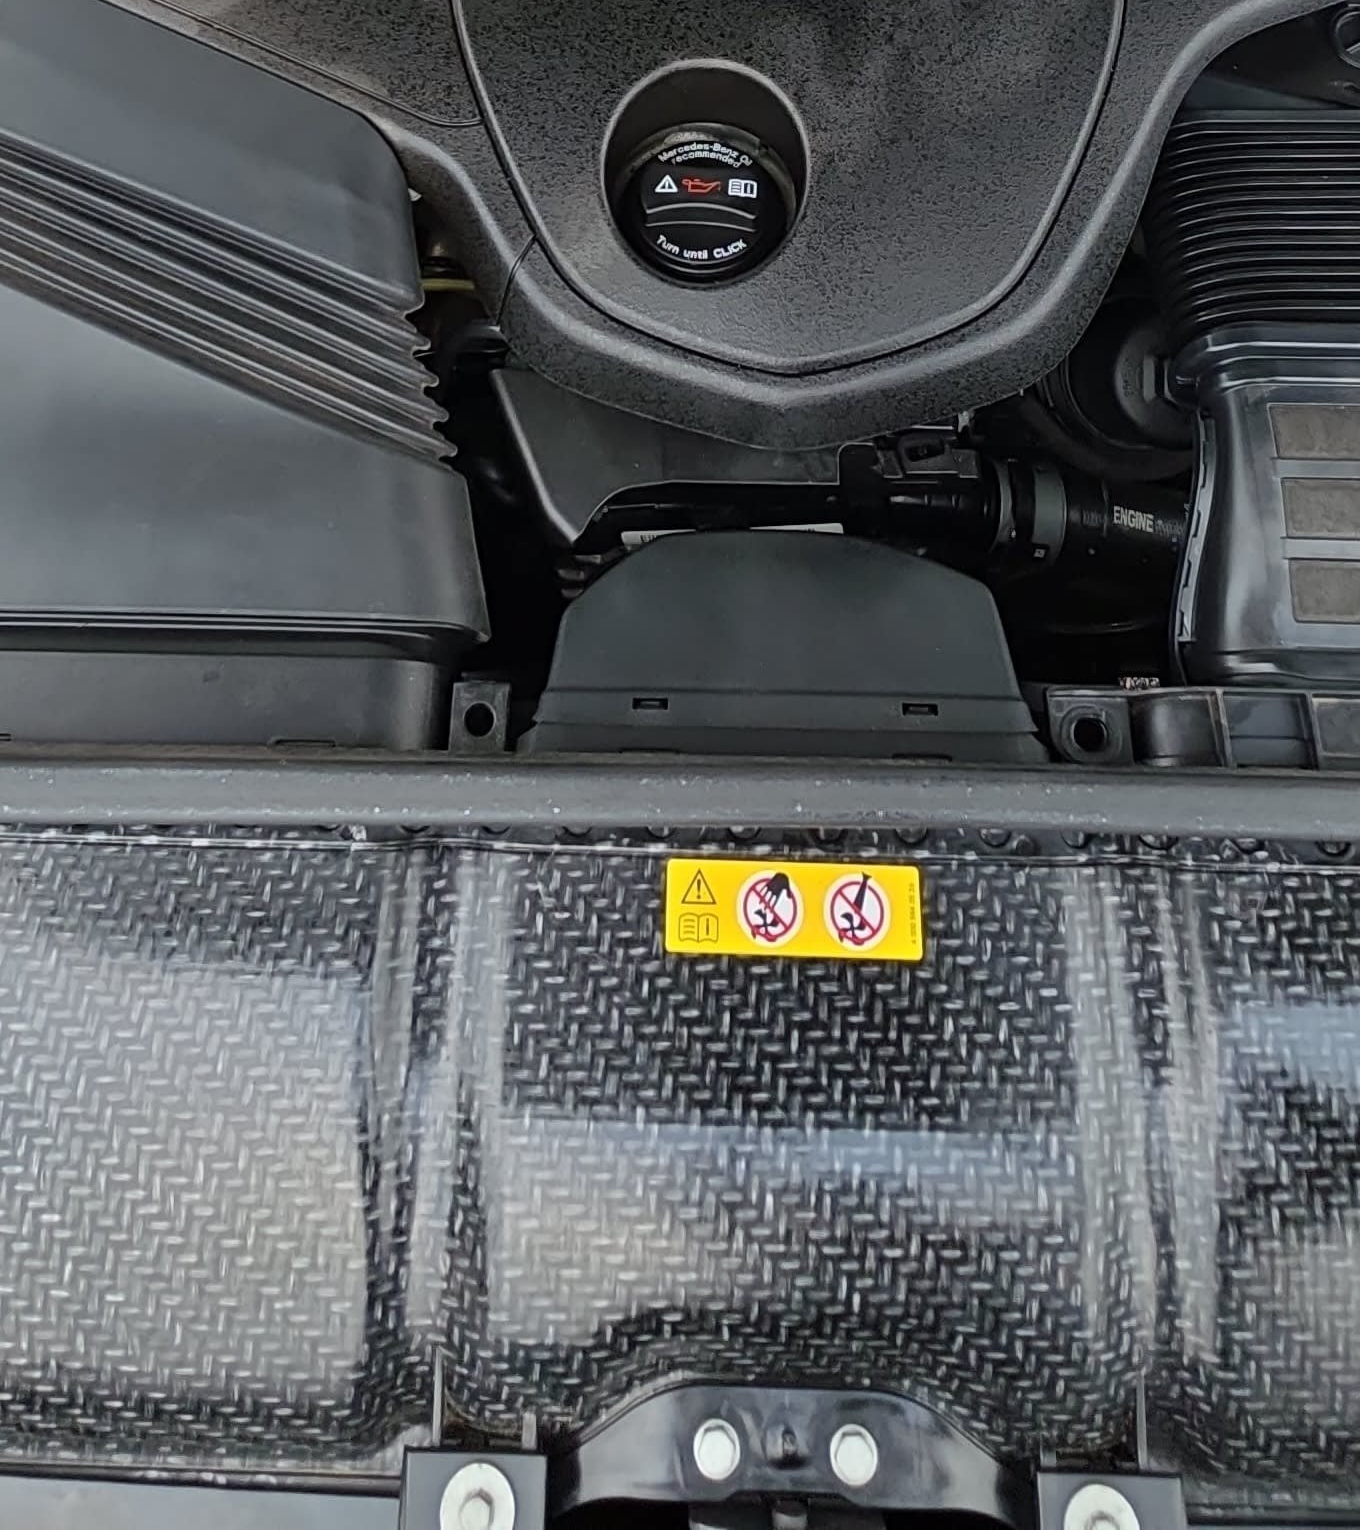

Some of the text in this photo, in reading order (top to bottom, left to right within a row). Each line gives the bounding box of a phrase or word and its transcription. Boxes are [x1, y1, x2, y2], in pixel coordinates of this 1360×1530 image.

[658, 142, 740, 163] Mercedes-Benz
[671, 151, 742, 168] recommended
[657, 234, 747, 259] Turn until CLICK
[1113, 506, 1155, 533] ENGINE
